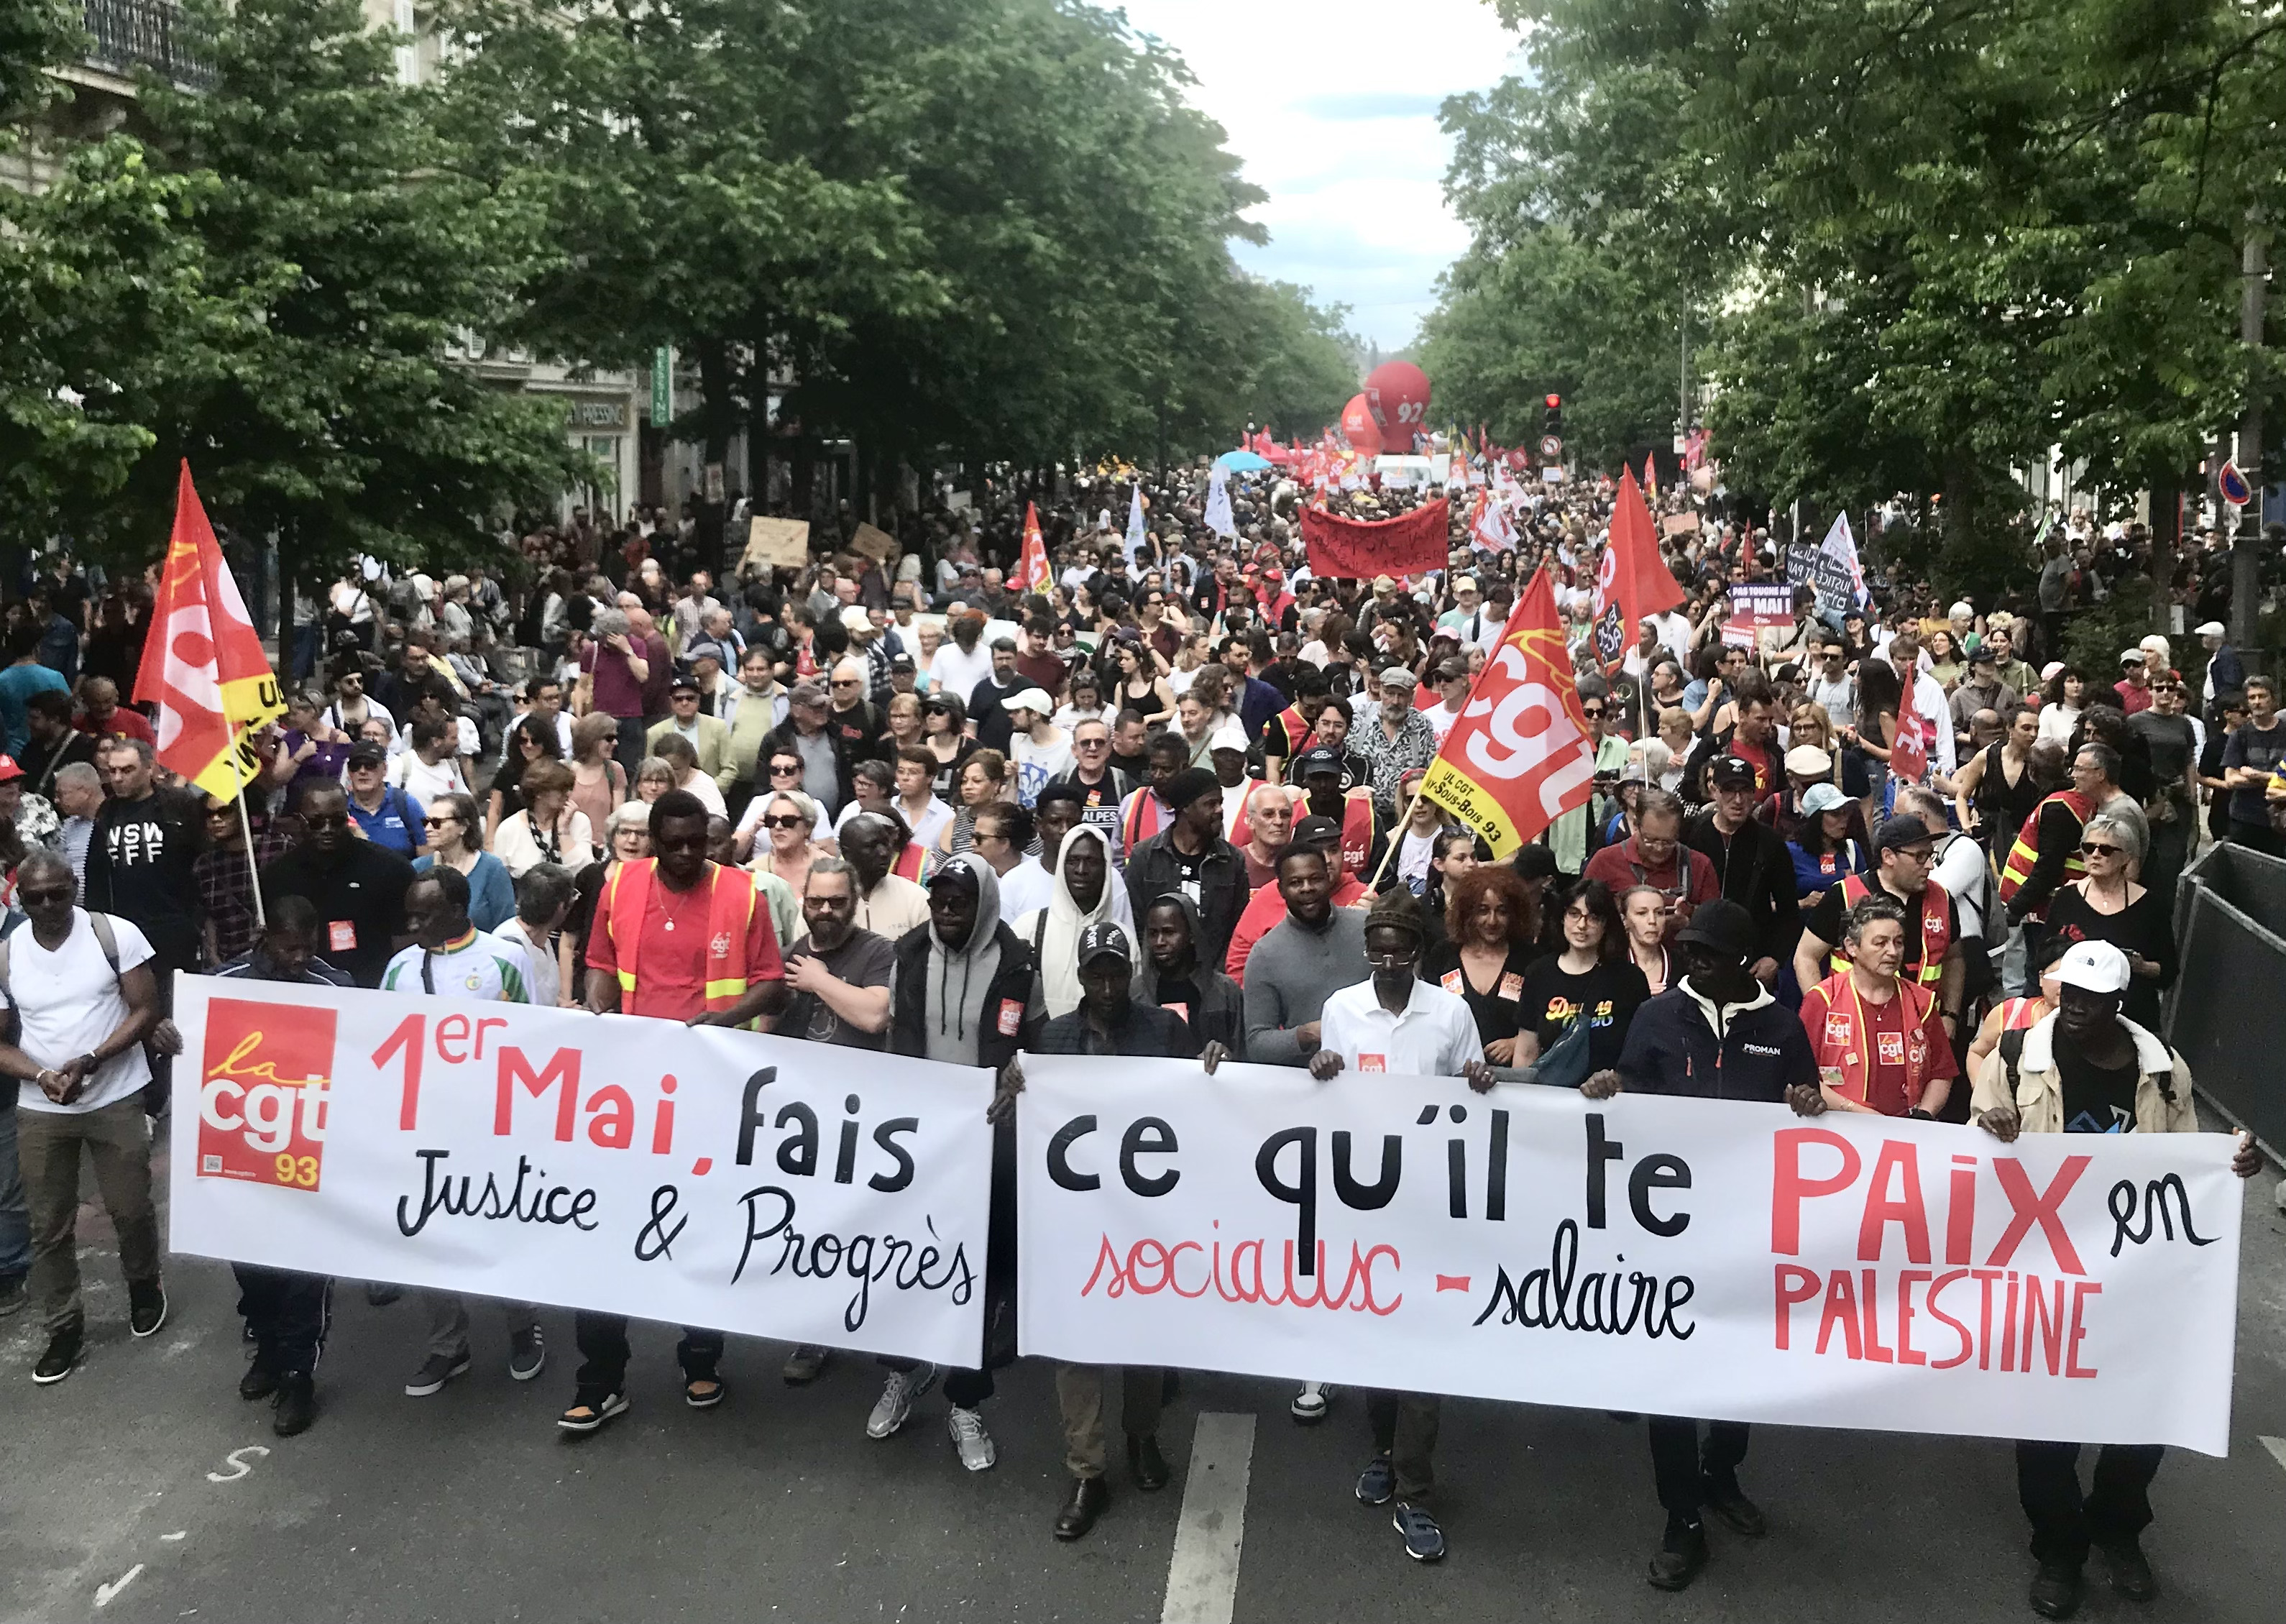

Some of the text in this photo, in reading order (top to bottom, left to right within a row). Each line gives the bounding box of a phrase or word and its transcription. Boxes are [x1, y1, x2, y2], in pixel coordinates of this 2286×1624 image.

[1397, 401, 1423, 423] 92
[1732, 587, 1748, 596] PAS
[1780, 586, 1791, 595] AU
[1733, 597, 1751, 614] 1ER
[1753, 597, 1783, 614] MAI
[1443, 771, 1475, 797] UL CGT
[1081, 811, 1117, 822] ALPES
[1482, 821, 1502, 842] 93
[1343, 850, 1364, 863] cgt
[1820, 863, 1836, 873] cgt
[1924, 916, 1944, 932] cgt
[1827, 1023, 1850, 1038] cgt
[208, 1030, 316, 1084] la
[1744, 1043, 1781, 1055] PROMAN
[1880, 1041, 1904, 1058] cgt
[201, 1074, 331, 1152] cgt
[372, 1013, 509, 1131] 1er
[735, 1065, 919, 1193] fais
[1047, 1114, 1180, 1197] ce
[1255, 1104, 1509, 1276] qu'il
[1585, 1112, 1692, 1237] te
[275, 1153, 318, 1187] 93
[2108, 1173, 2222, 1257] en
[397, 1150, 978, 1333] Justice & Progrès
[1472, 1218, 1695, 1341] salaire
